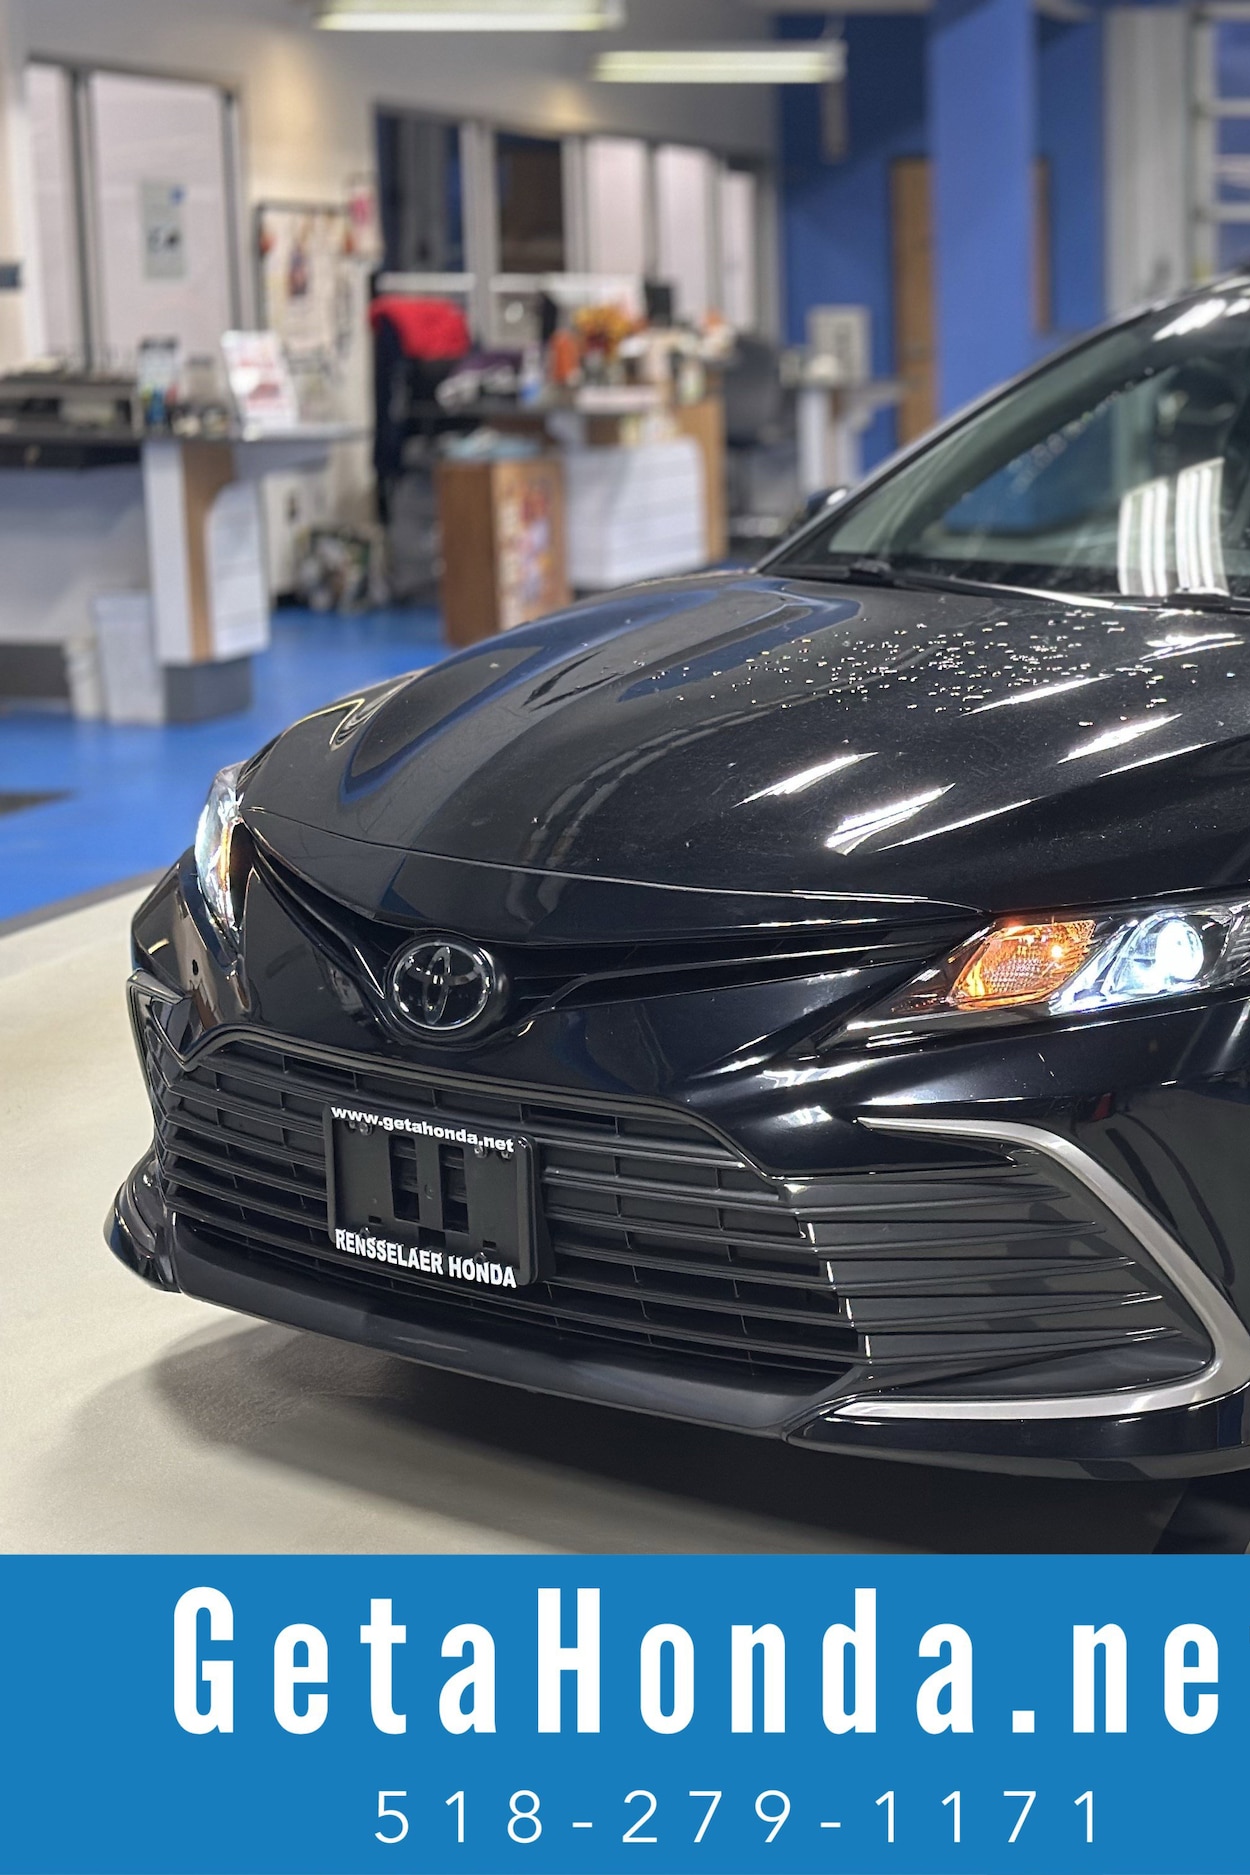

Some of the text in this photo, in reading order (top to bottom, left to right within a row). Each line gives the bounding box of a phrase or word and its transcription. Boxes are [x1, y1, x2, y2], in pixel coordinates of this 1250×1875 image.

[331, 1106, 515, 1152] www.getahonda.net
[335, 1228, 518, 1288] RENSSELAER HONDA
